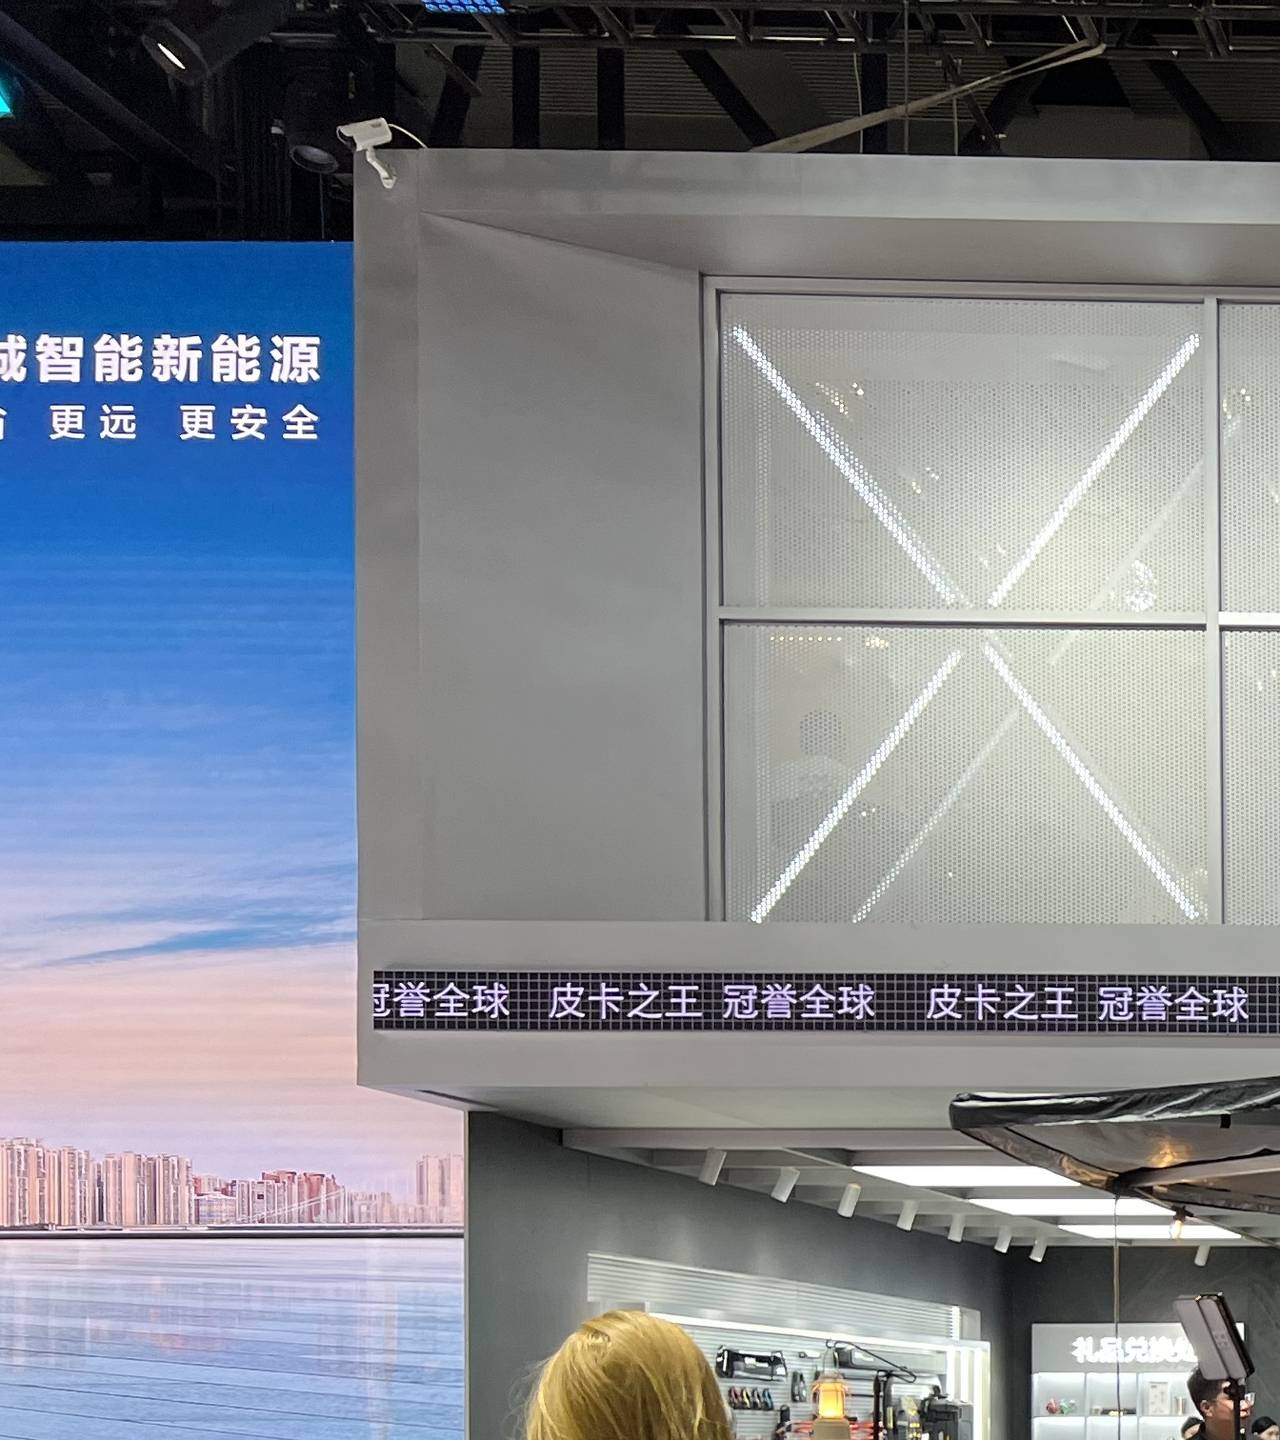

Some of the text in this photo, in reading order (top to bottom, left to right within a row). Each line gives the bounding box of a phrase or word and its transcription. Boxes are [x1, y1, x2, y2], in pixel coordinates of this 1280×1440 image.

[50, 404, 318, 439] 更远 更安全
[549, 983, 702, 1019] 皮卡之王
[723, 984, 874, 1019] 冠誉全球
[927, 984, 1078, 1020] 皮卡之王
[1099, 986, 1248, 1022] 冠誉全球
